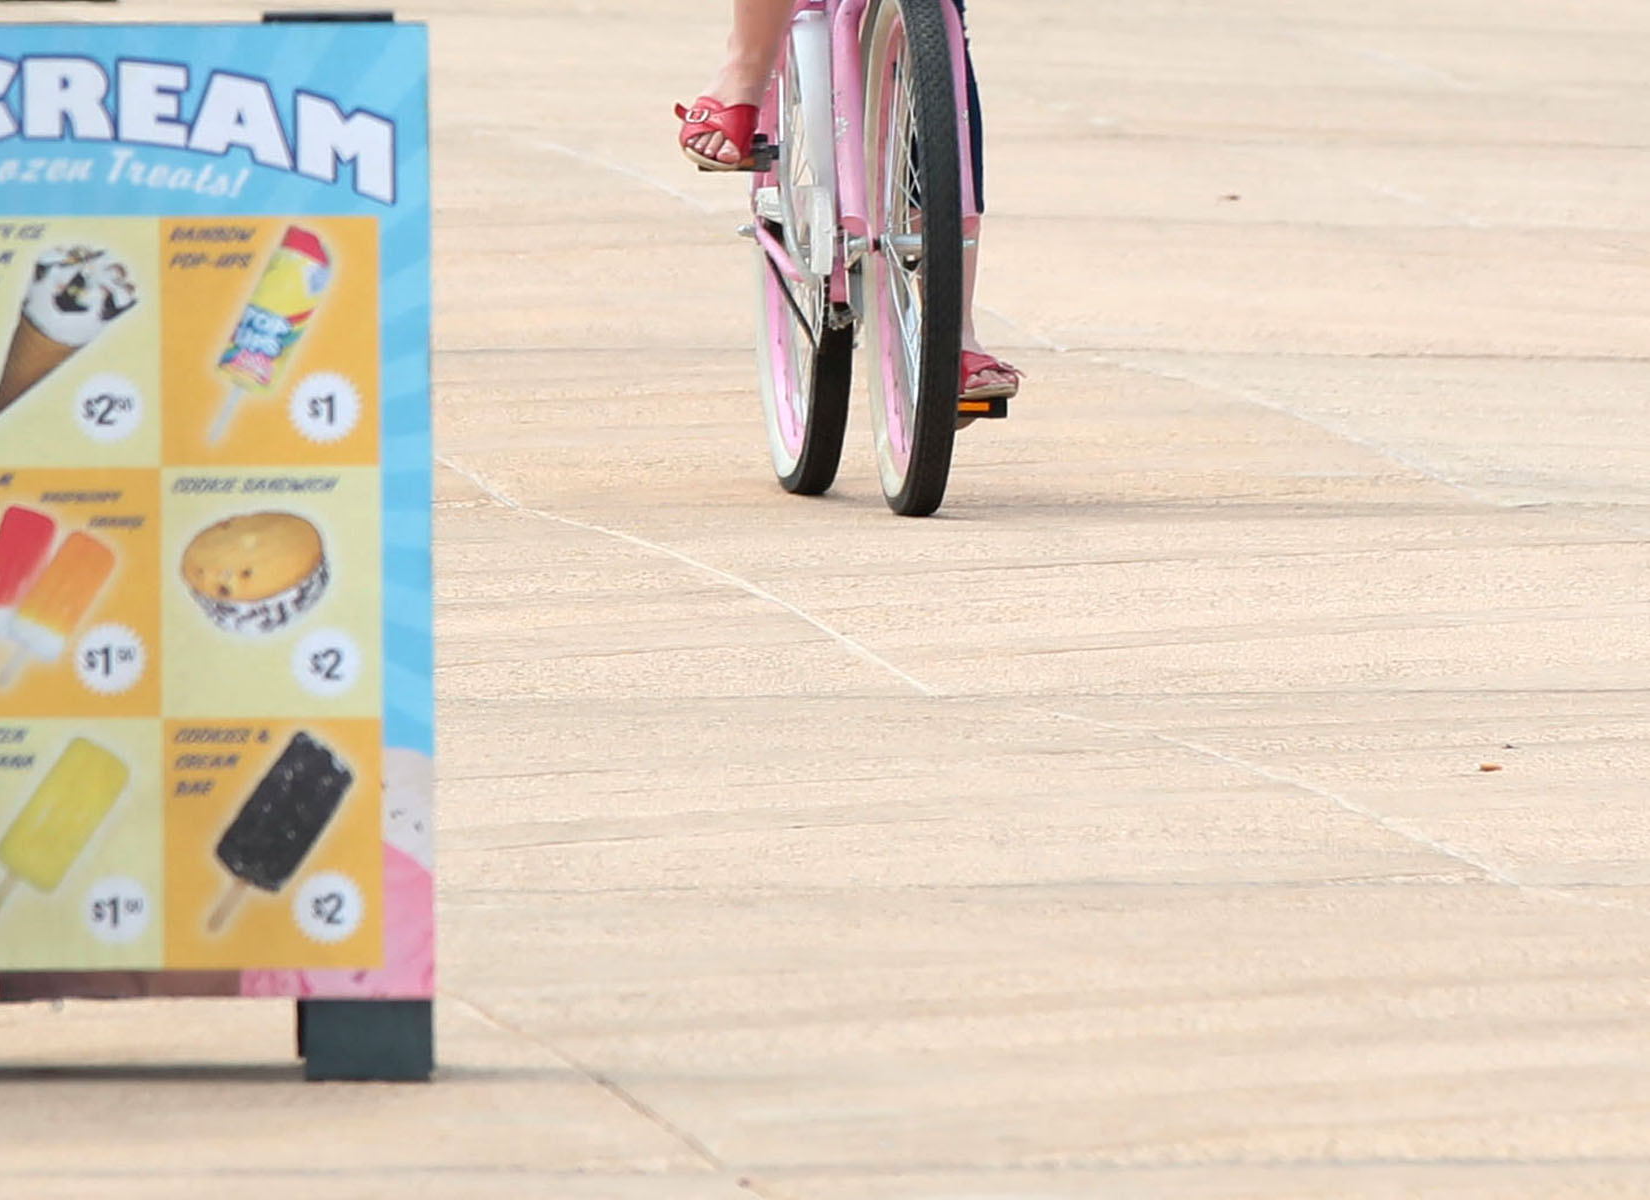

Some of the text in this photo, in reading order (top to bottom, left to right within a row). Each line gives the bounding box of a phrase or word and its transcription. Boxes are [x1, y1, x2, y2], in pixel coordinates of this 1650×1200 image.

[106, 148, 249, 199] Treats!
[17, 224, 45, 240] ICE
[170, 227, 256, 243] RAINBOW
[307, 395, 335, 426] $1
[173, 476, 339, 493] COOKIE SANDWICH
[310, 648, 343, 681] $2
[173, 728, 252, 744] COOKIES
[173, 754, 239, 770] CREAM
[173, 780, 216, 797] BAR
[310, 892, 344, 925] $2
